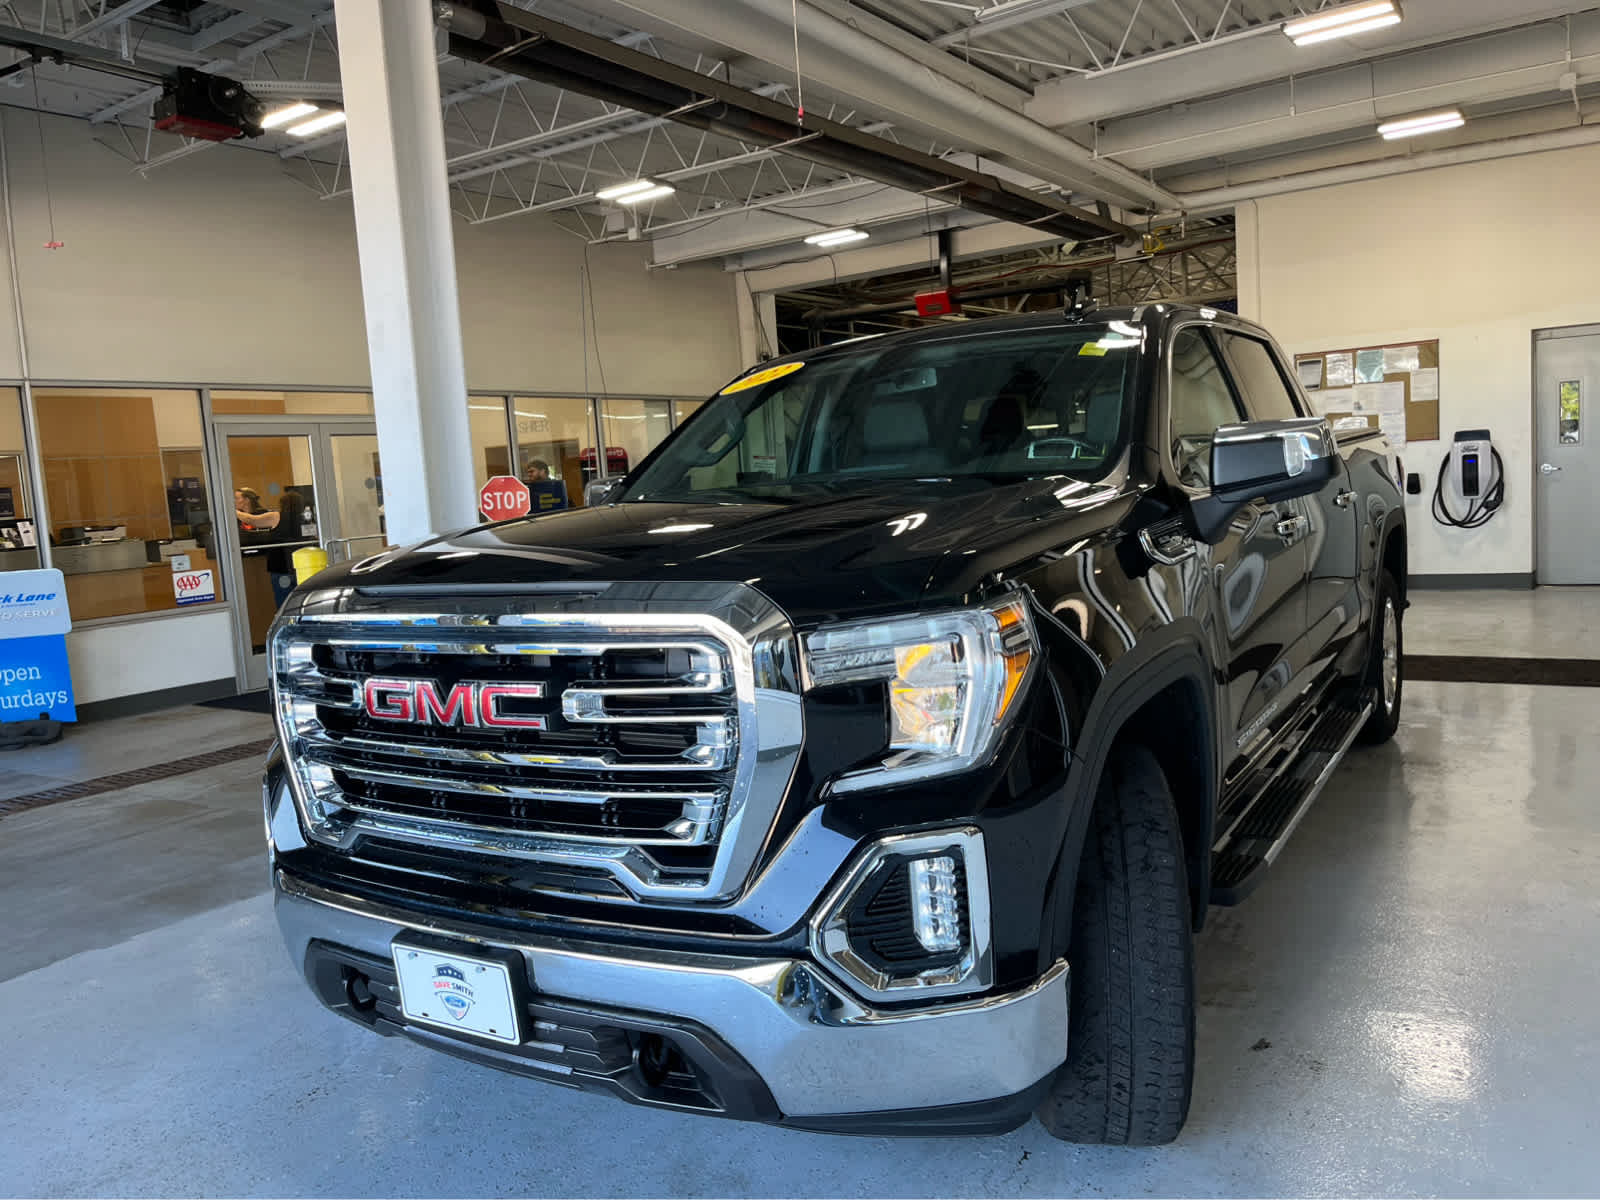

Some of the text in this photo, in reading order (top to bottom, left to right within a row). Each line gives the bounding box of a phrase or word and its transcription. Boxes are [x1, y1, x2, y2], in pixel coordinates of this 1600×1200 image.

[517, 421, 552, 432] SHIER
[483, 491, 527, 510] STOP
[177, 576, 201, 590] AAA
[16, 593, 56, 602] Lane
[0, 666, 41, 686] pen
[0, 689, 68, 709] urdays
[364, 677, 547, 730] GMC
[452, 982, 474, 998] SMITH
